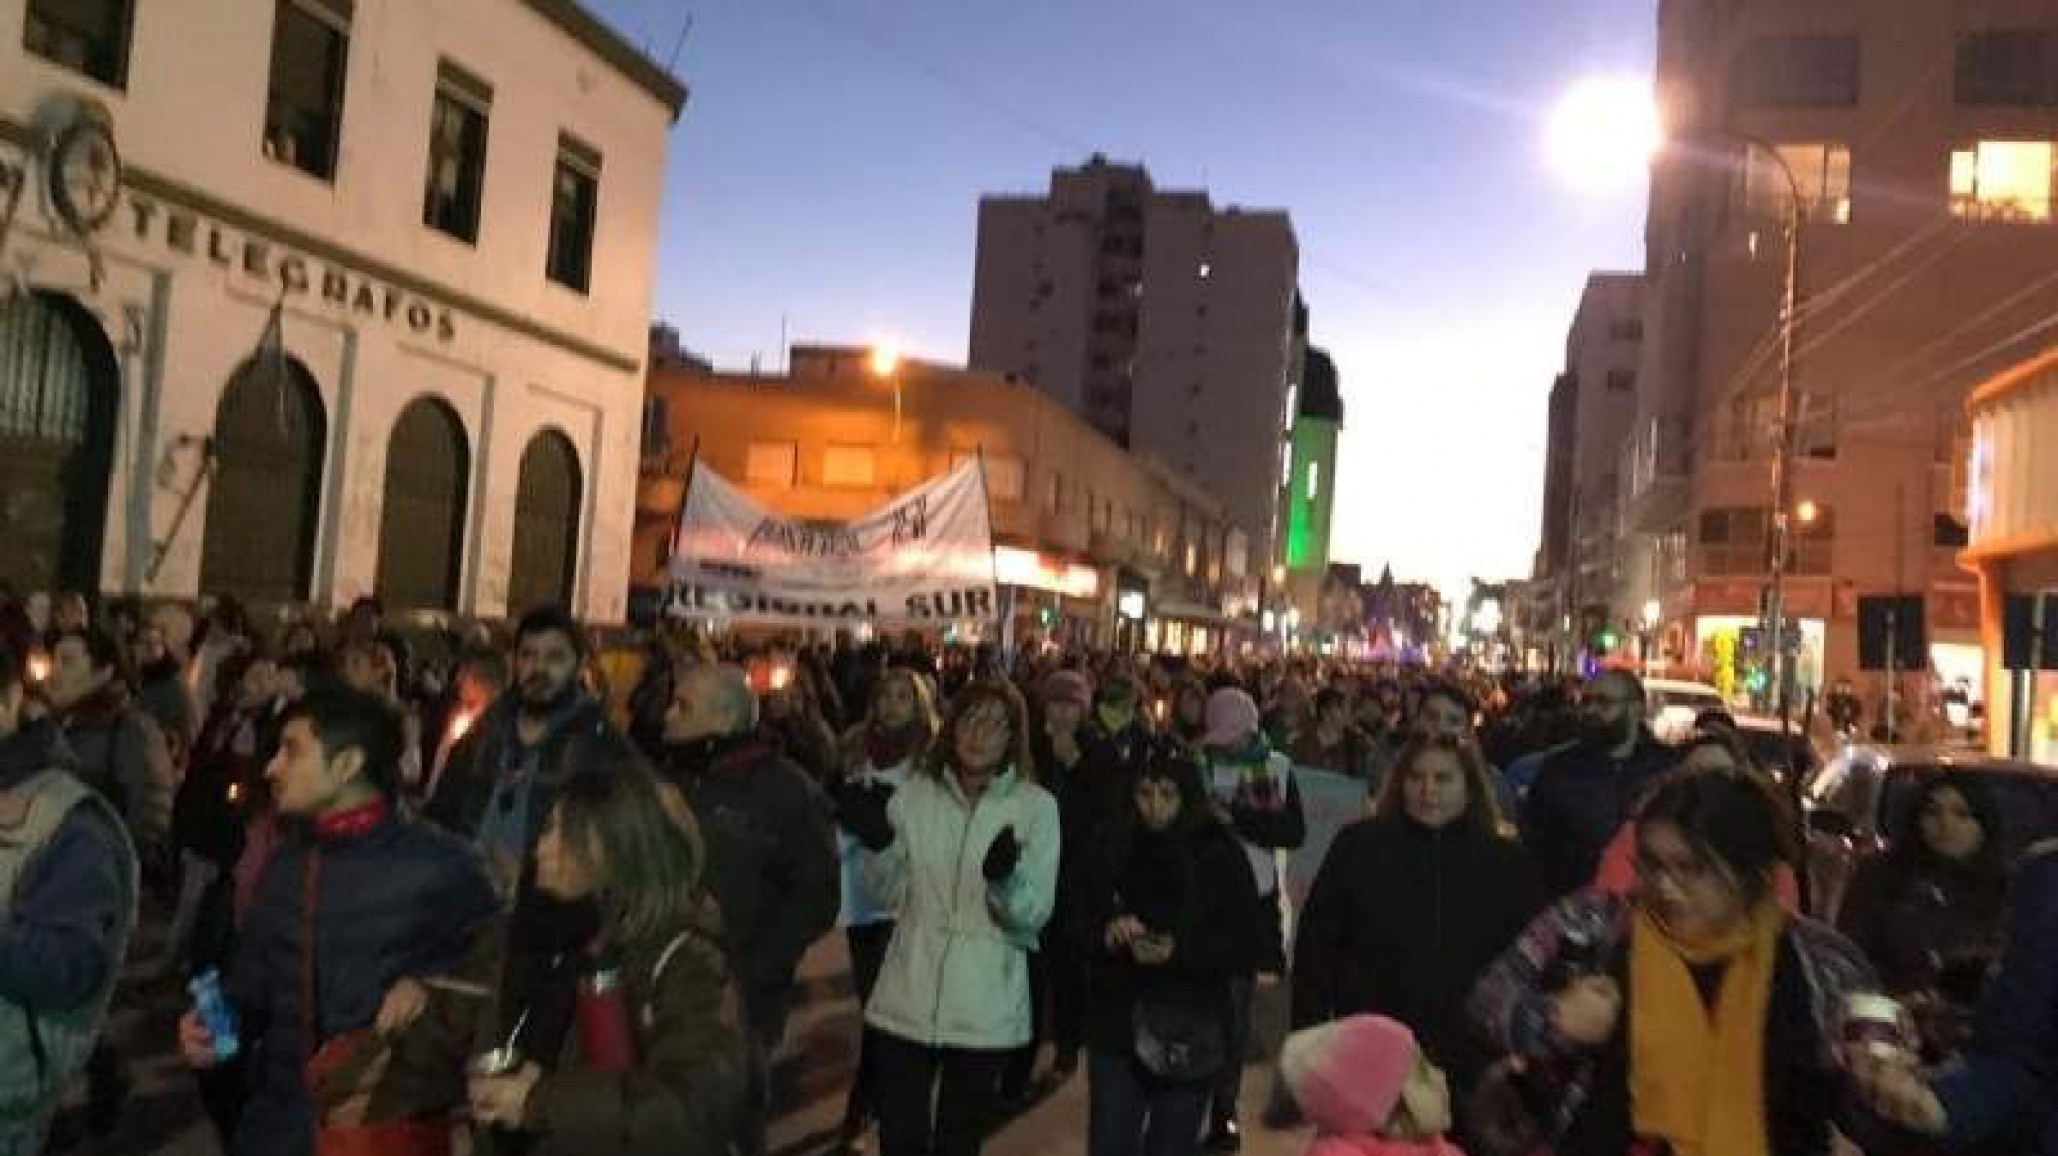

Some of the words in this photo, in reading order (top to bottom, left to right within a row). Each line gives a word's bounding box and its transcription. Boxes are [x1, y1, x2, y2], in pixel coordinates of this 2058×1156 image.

[131, 200, 455, 342] TELEGRAFOS
[669, 579, 876, 617] REGIONAL
[905, 586, 991, 618] SUR
